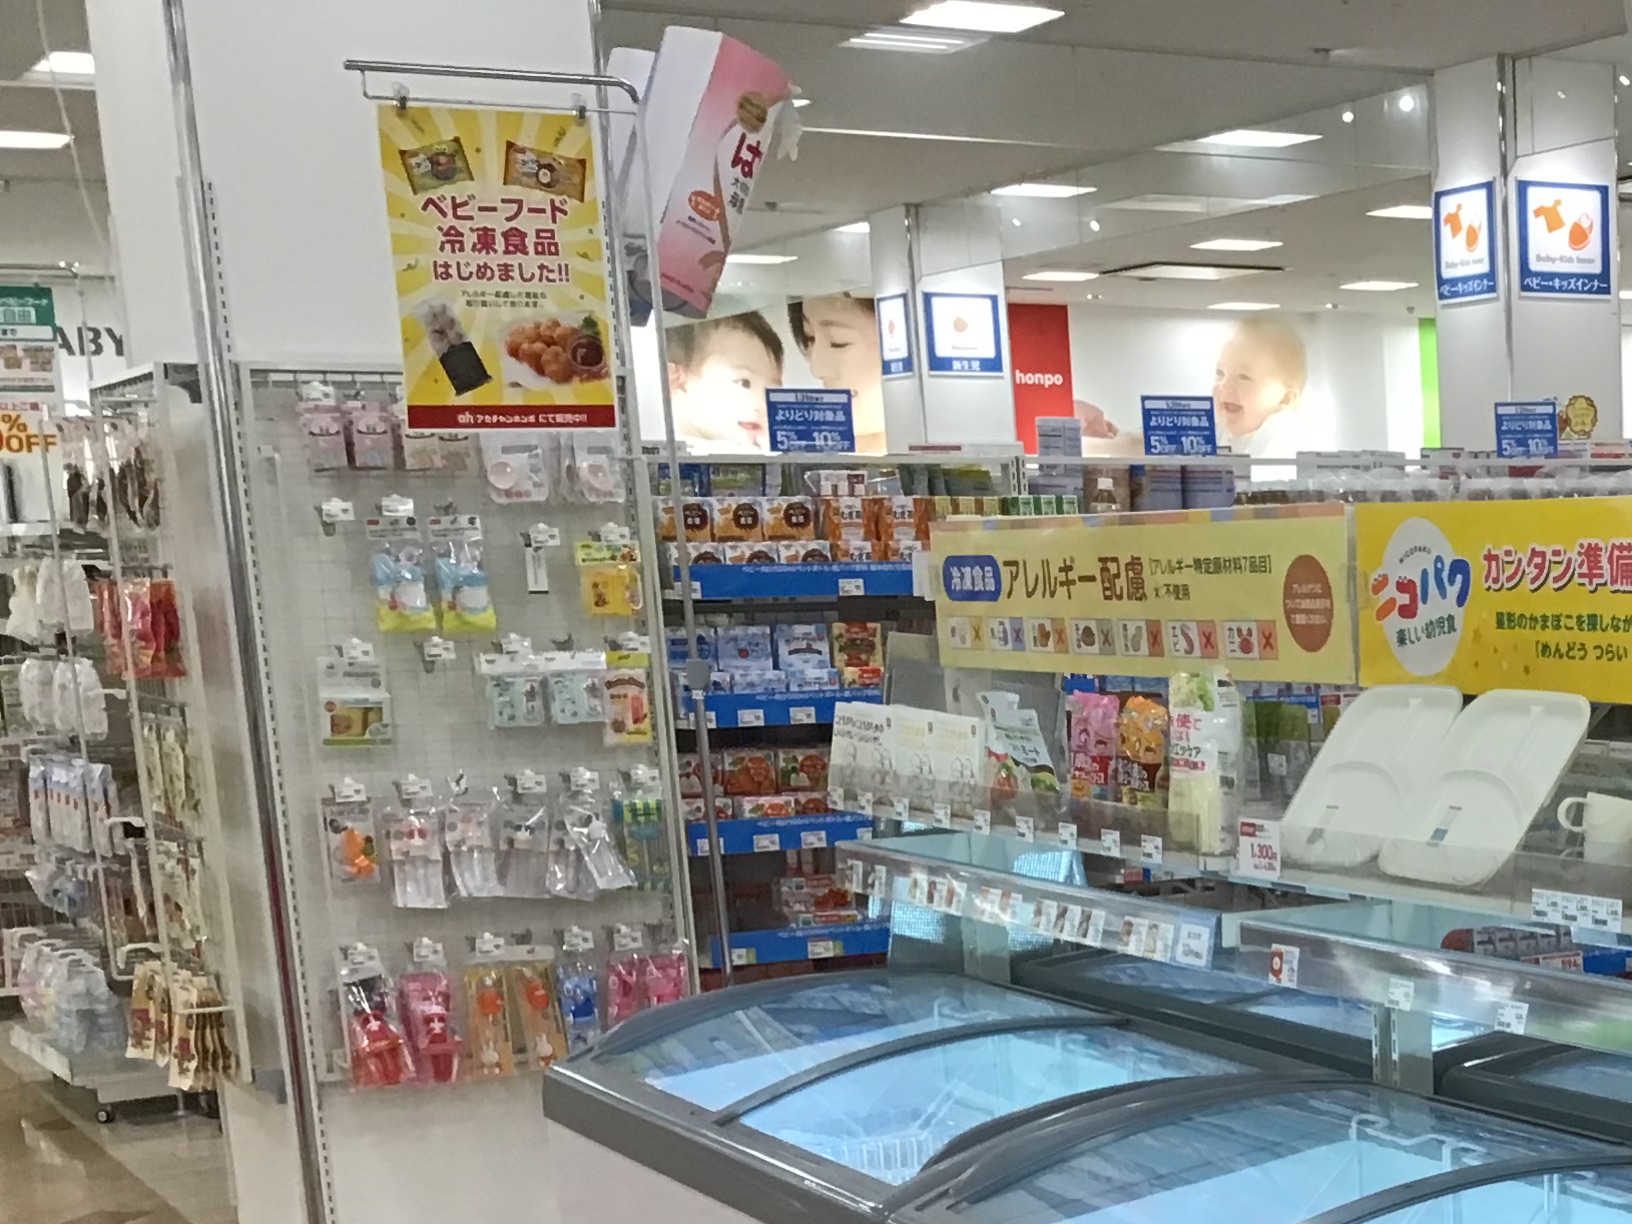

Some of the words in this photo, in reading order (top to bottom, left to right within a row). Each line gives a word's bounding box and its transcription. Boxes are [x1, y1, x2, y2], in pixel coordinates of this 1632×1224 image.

[421, 194, 568, 223] ベビーフード
[437, 226, 560, 256] 冷凍食品
[1015, 369, 1063, 388] honpo
[950, 566, 996, 592] 冷凍食品
[1003, 555, 1148, 601] アレルギー配慮
